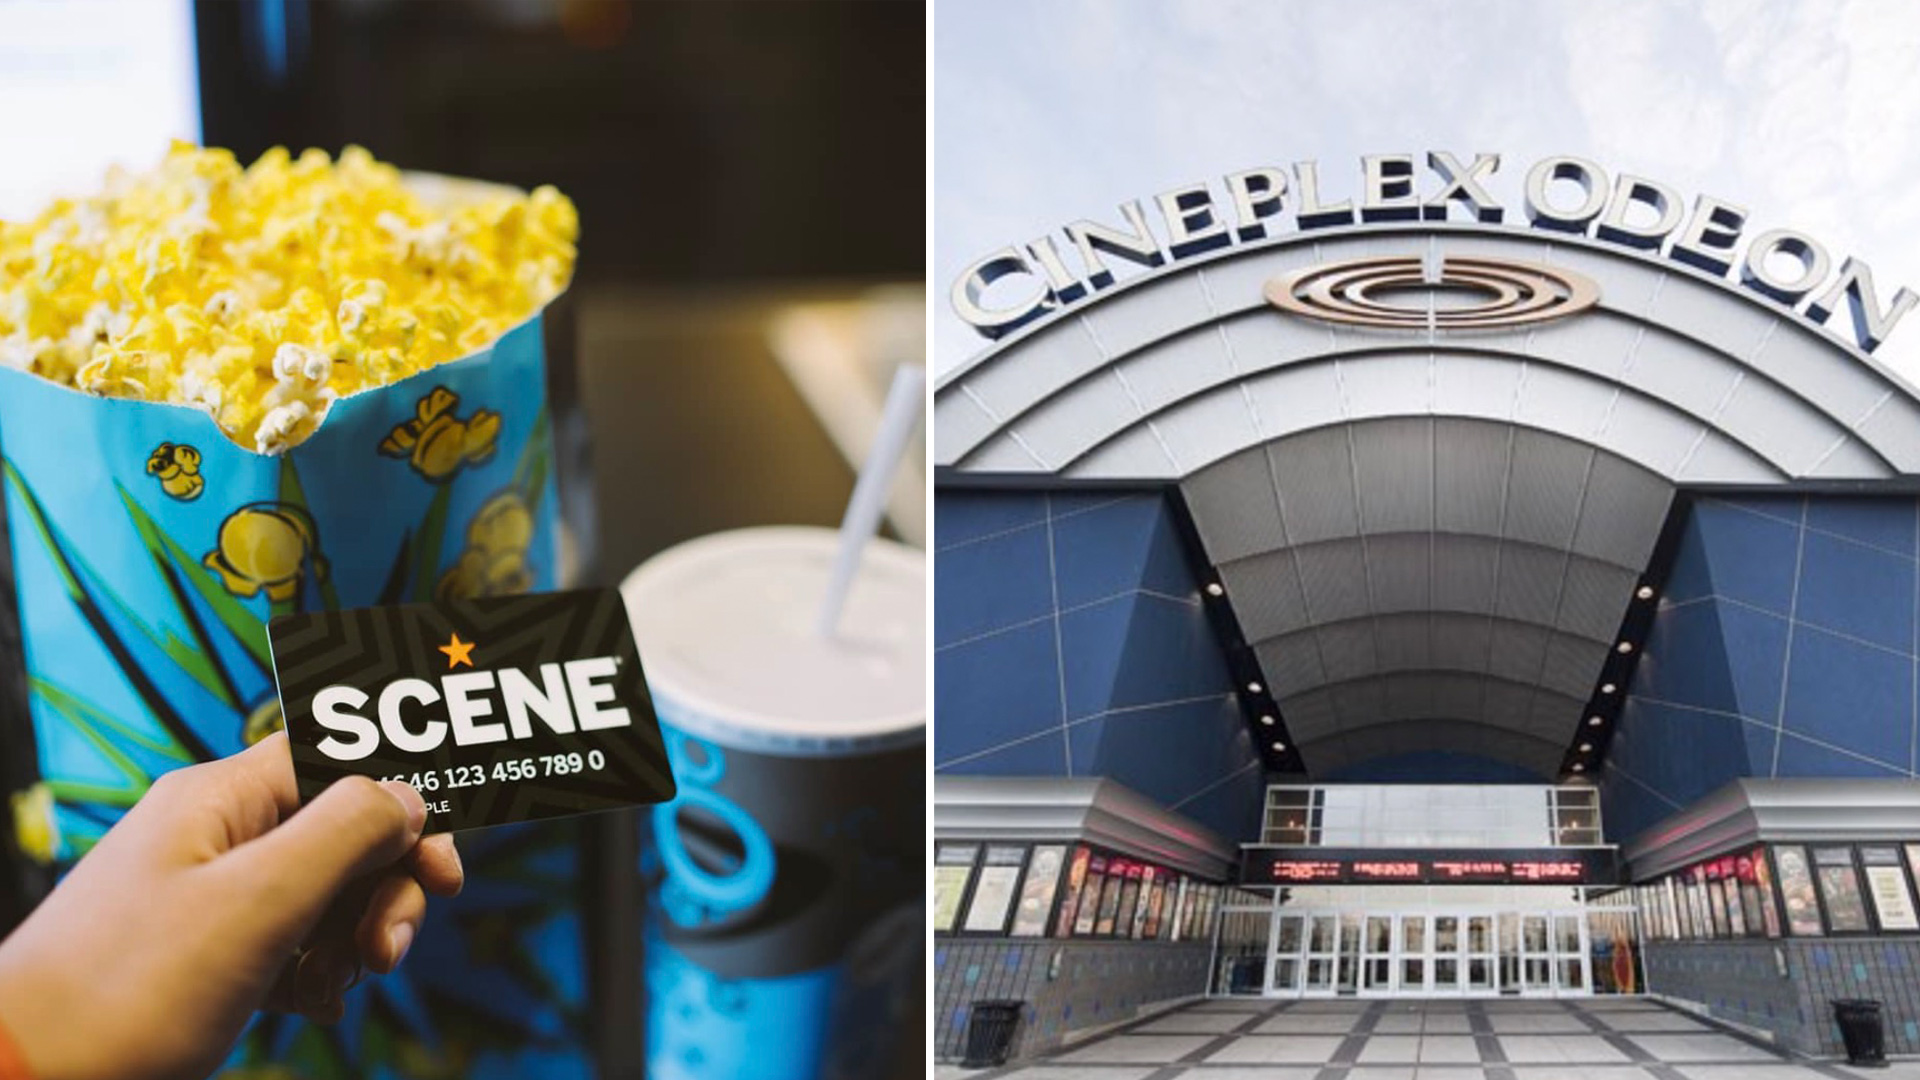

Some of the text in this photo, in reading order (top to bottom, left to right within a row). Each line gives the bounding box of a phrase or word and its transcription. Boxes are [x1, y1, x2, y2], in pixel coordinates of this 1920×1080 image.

[950, 151, 1920, 354] CINEPLEX ODEON
[311, 656, 632, 761] SCENE
[444, 764, 486, 789] 123
[491, 758, 537, 782] 456
[539, 752, 584, 777] 789
